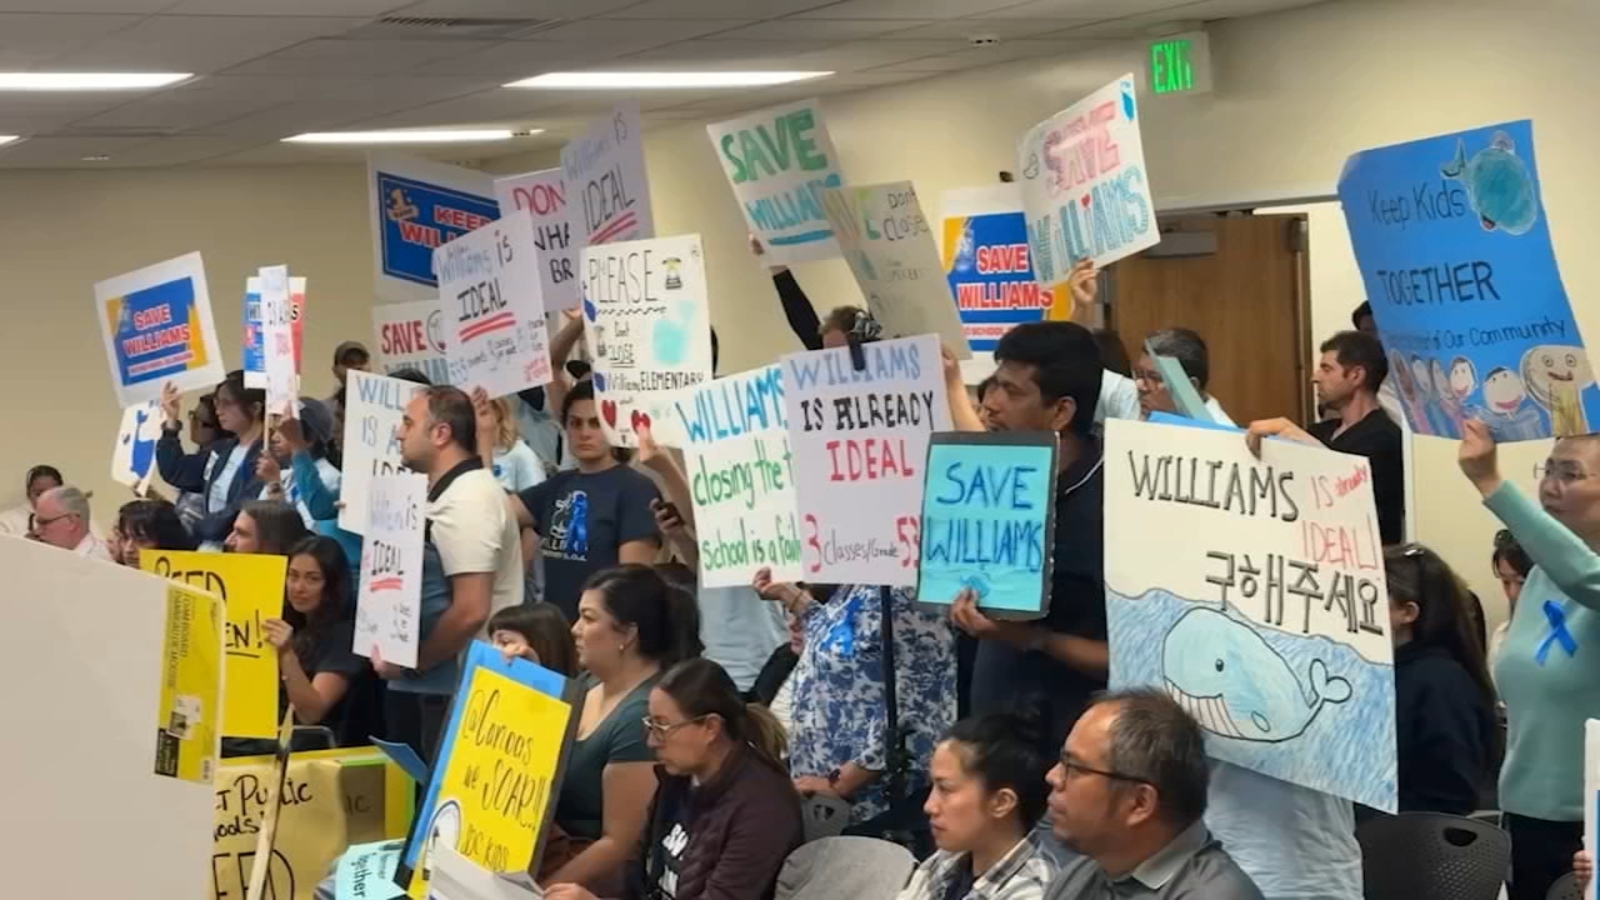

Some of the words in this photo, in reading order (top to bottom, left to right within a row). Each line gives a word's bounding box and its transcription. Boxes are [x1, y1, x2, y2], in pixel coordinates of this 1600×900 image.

[1150, 40, 1192, 92] EXIT
[720, 108, 828, 185] SAVE
[1042, 101, 1121, 192] SAVE
[582, 162, 636, 235] IDEAL
[1367, 190, 1410, 231] Keep
[1412, 179, 1467, 220] Kids
[588, 249, 658, 305] PLEASE
[976, 244, 1030, 274] SAVE
[457, 277, 507, 322] IDEAL
[957, 281, 1055, 310] WILLIAMS
[1376, 260, 1501, 306] TOGETHER
[123, 323, 190, 358] WILLIAMS
[132, 303, 172, 331] SAVE
[382, 320, 427, 355] SAVE
[1469, 316, 1566, 347] Community
[789, 342, 921, 391] WILIAMS
[362, 415, 378, 447] IS
[801, 397, 824, 431] IS
[833, 389, 934, 431] ALREADY
[693, 453, 756, 510] closing
[826, 437, 915, 482] IDEAL
[936, 461, 1038, 511] SAVE
[1127, 449, 1300, 522] WILLIAMS
[1311, 474, 1334, 510] IS
[372, 539, 405, 576] IDEAL
[752, 529, 766, 563] is
[805, 513, 822, 569] 3
[926, 516, 1043, 574] WILLIAMS
[1206, 550, 1384, 636] 구해주세요
